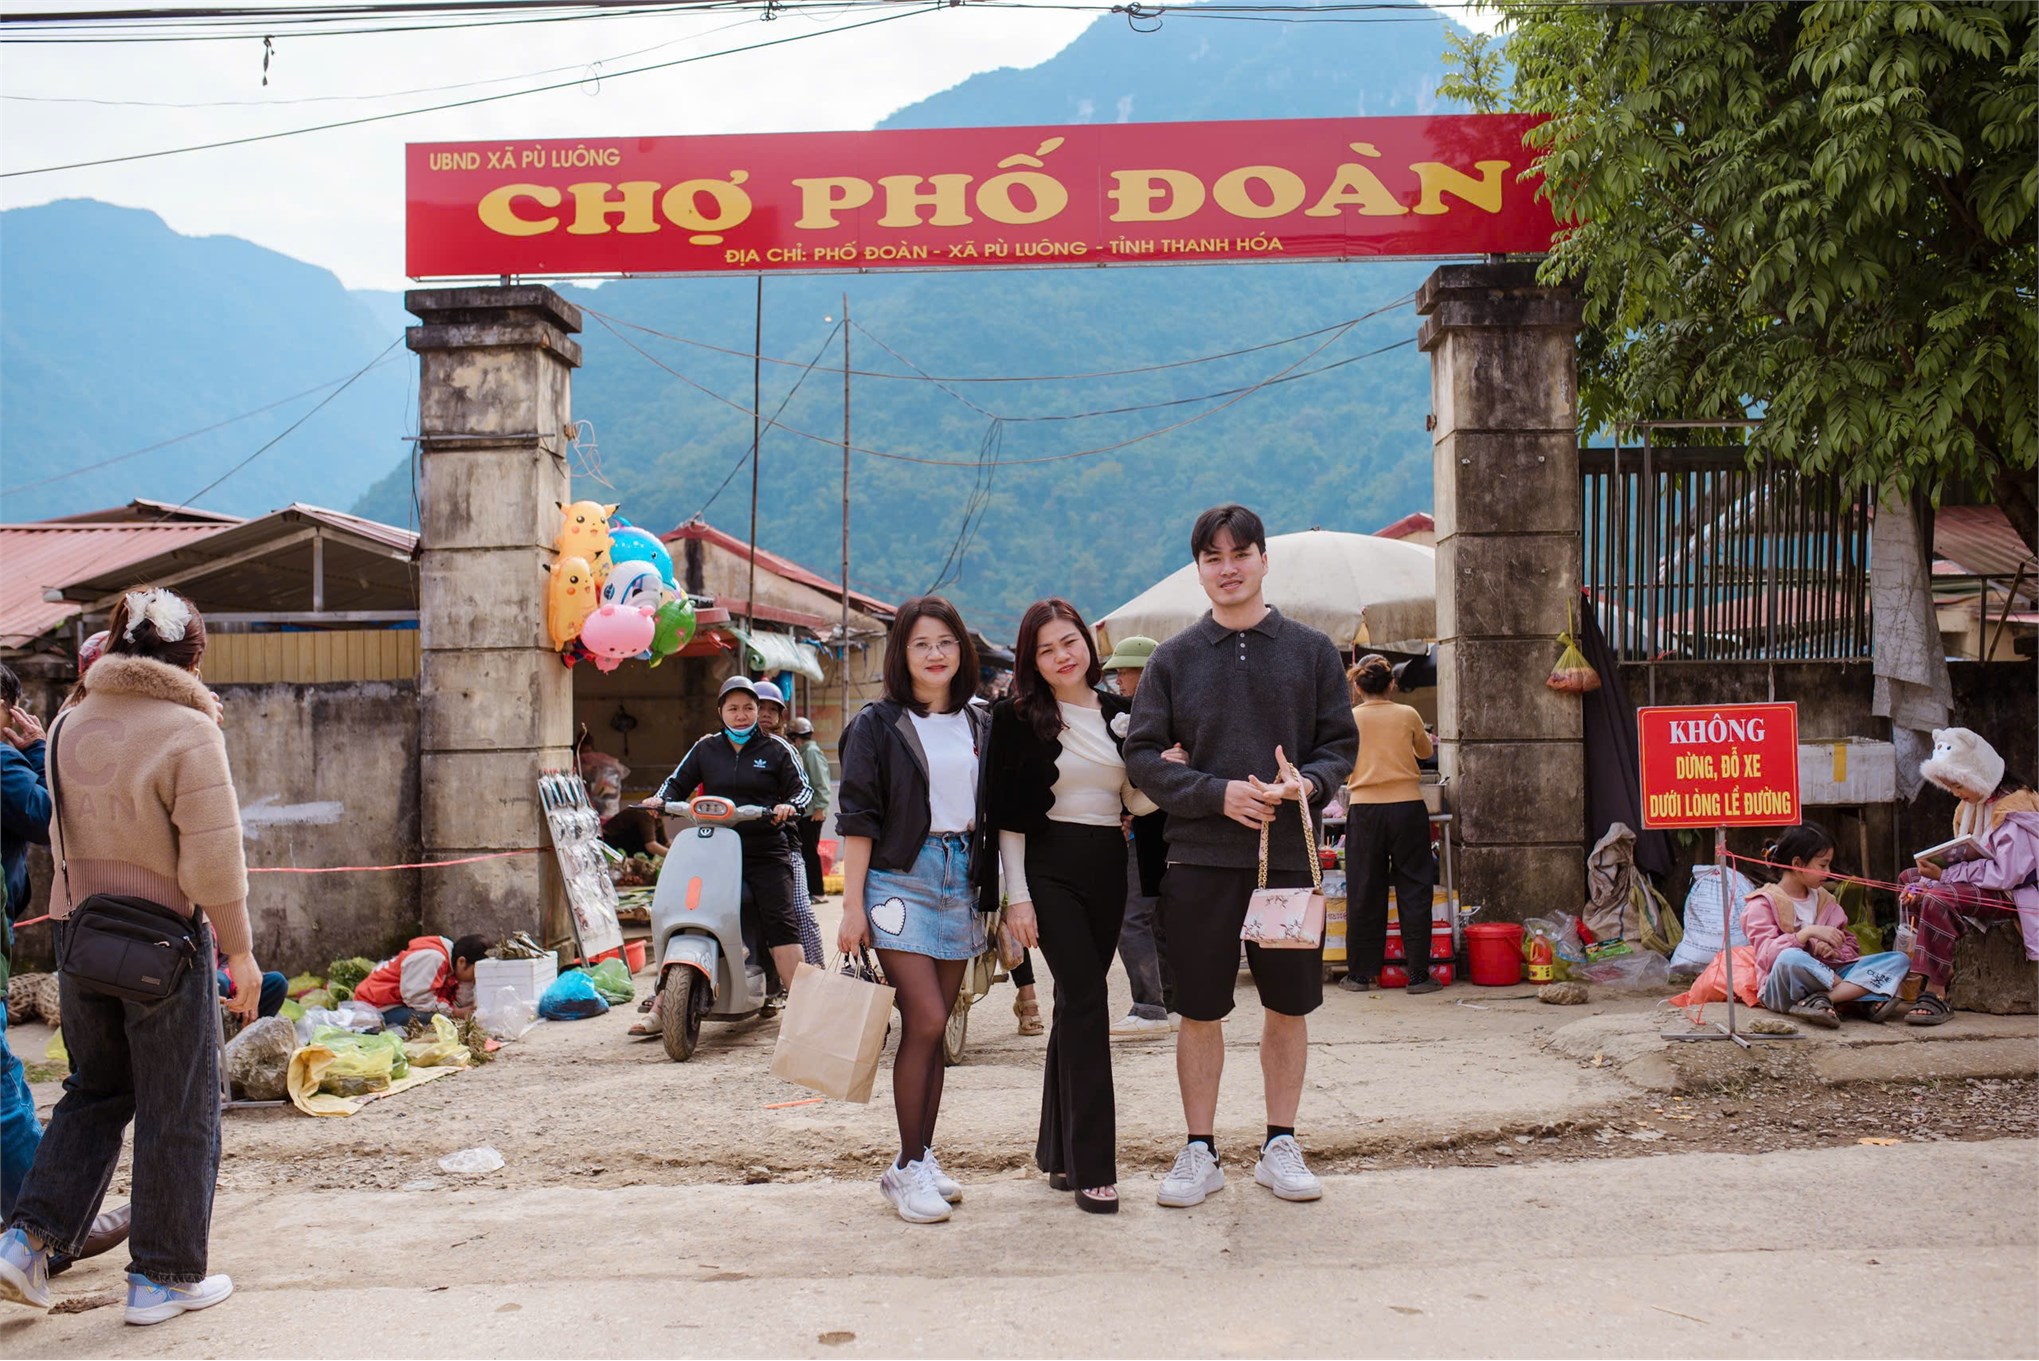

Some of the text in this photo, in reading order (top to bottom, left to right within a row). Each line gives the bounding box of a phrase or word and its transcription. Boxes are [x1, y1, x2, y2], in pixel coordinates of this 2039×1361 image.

[430, 144, 620, 170] UBND XÃ PÙ LUÔNG
[478, 137, 1510, 245] CHỢ PHỐ ĐOÀN
[725, 249, 760, 266] ĐỊA
[767, 242, 806, 261] CHỈ:
[815, 241, 856, 260] PHỐ
[864, 241, 927, 259] ĐOÀN
[949, 241, 977, 257] XÃ
[985, 239, 1007, 256] PÙ
[1016, 239, 1087, 256] LUÔNG
[1110, 236, 1153, 253] TỈNH
[1161, 239, 1228, 252] THANH
[1237, 231, 1283, 250] HÓA
[1669, 713, 1765, 743] KHÔNG
[1677, 747, 1761, 781] DỪNG, ĐỖ XE
[1650, 785, 1791, 817] DƯỚI LÒNG LỀ ĐƯỜNG
